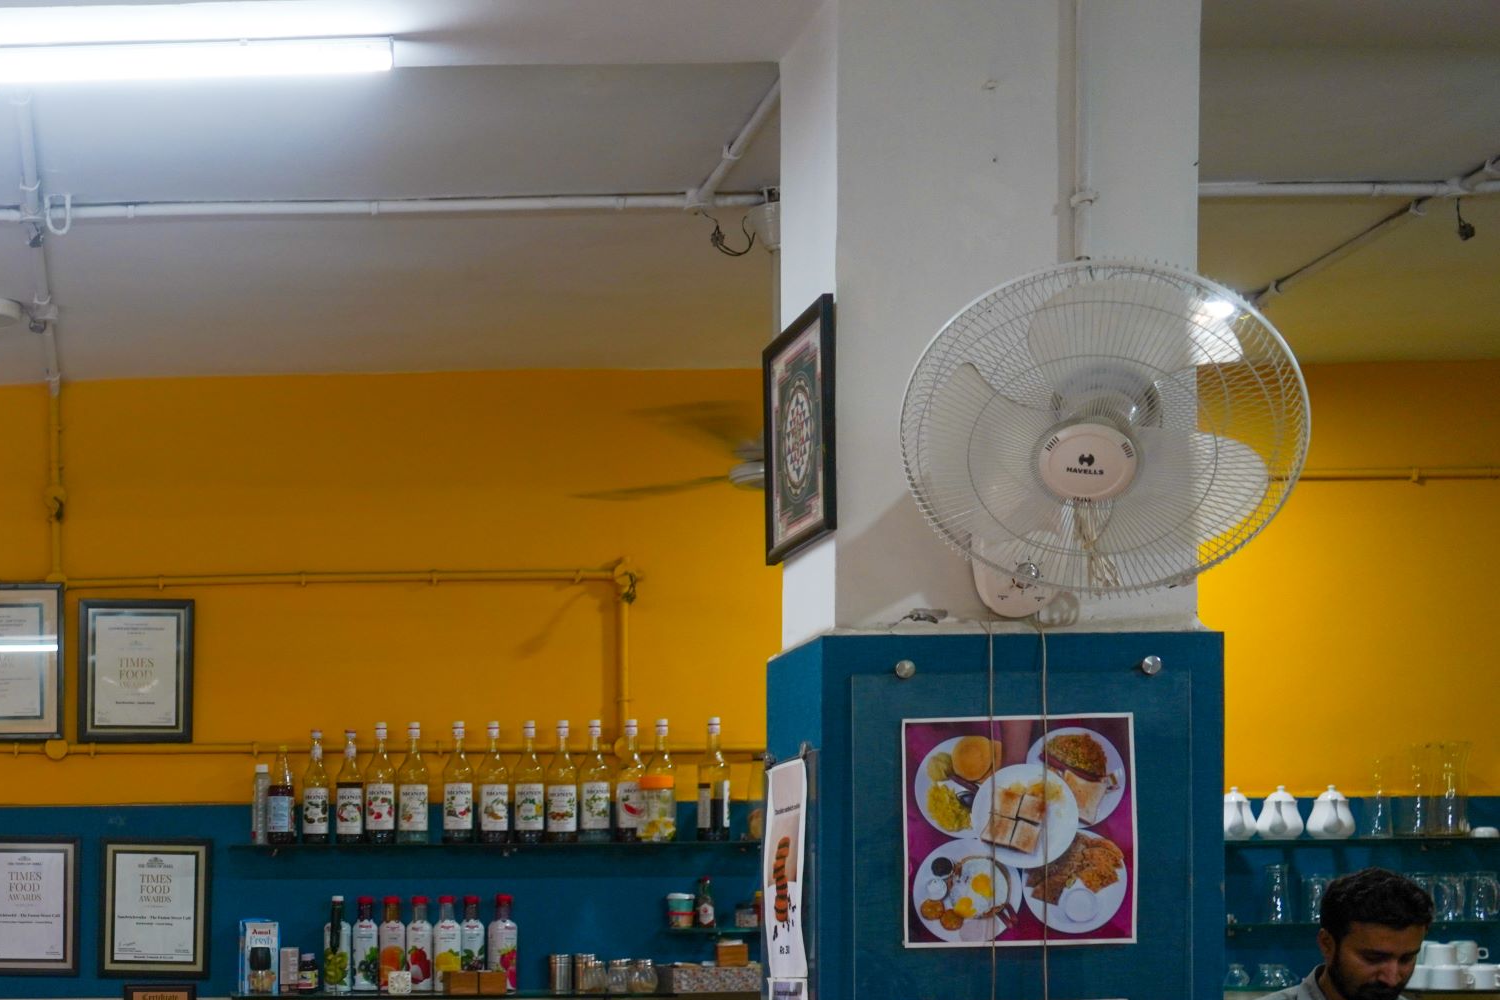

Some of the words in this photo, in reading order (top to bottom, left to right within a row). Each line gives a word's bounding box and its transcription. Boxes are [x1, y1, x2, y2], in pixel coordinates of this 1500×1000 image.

[1066, 467, 1104, 475] HAVELLS
[118, 657, 154, 668] TIMES
[119, 670, 152, 680] FOOD
[7, 871, 42, 880] TIMES
[139, 873, 172, 883] TIMES
[9, 882, 40, 892] FOOD
[140, 885, 170, 894] FOOD
[250, 935, 272, 944] Fresh
[141, 993, 178, 1000] Certificate
